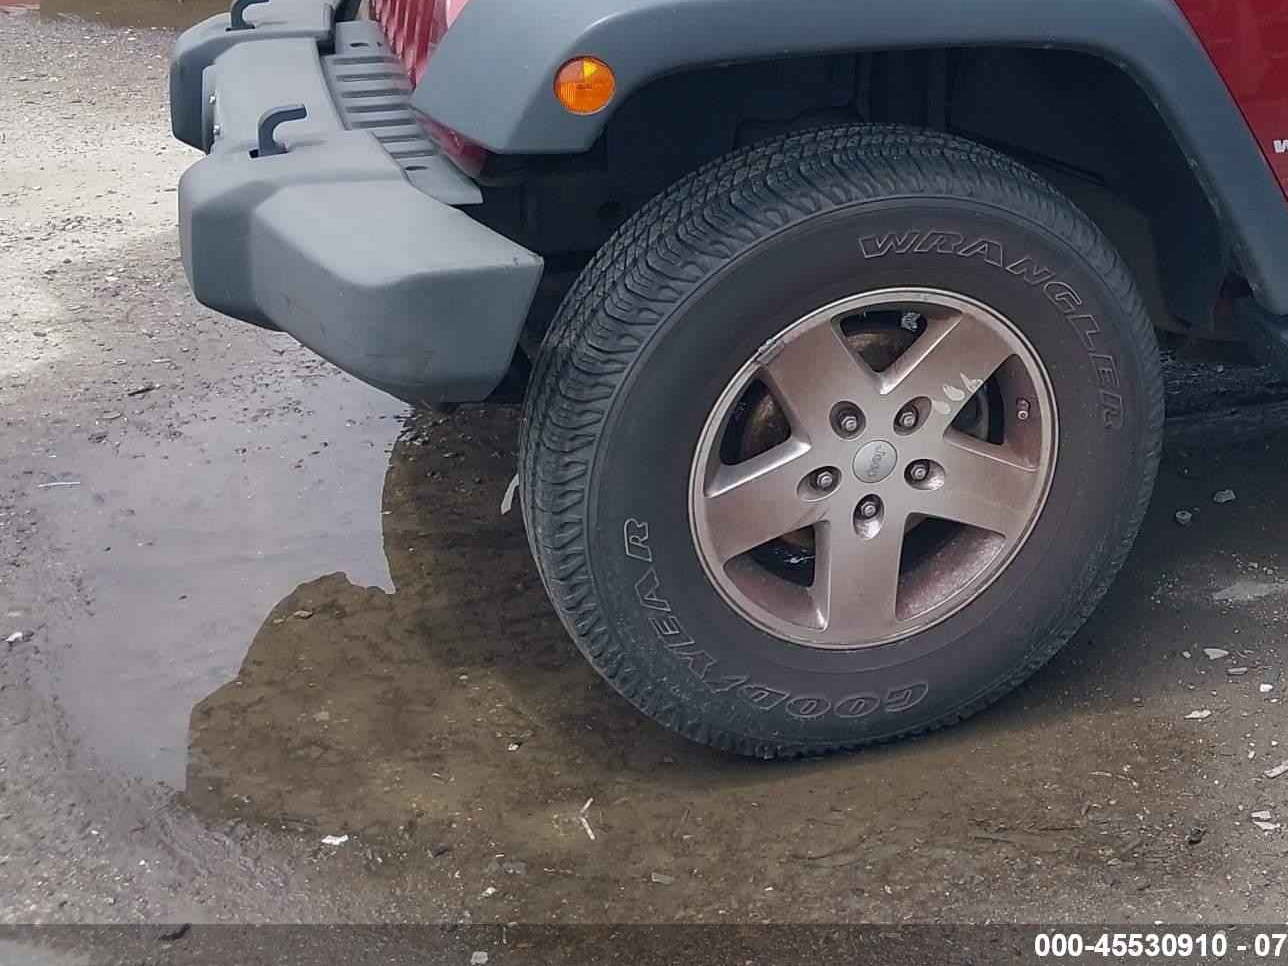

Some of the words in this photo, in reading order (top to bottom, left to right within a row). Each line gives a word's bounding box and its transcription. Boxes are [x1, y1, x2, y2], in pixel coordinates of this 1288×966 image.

[858, 230, 1124, 430] WRANGLER
[866, 444, 887, 478] Jeep
[623, 518, 929, 718] GOODYEAR
